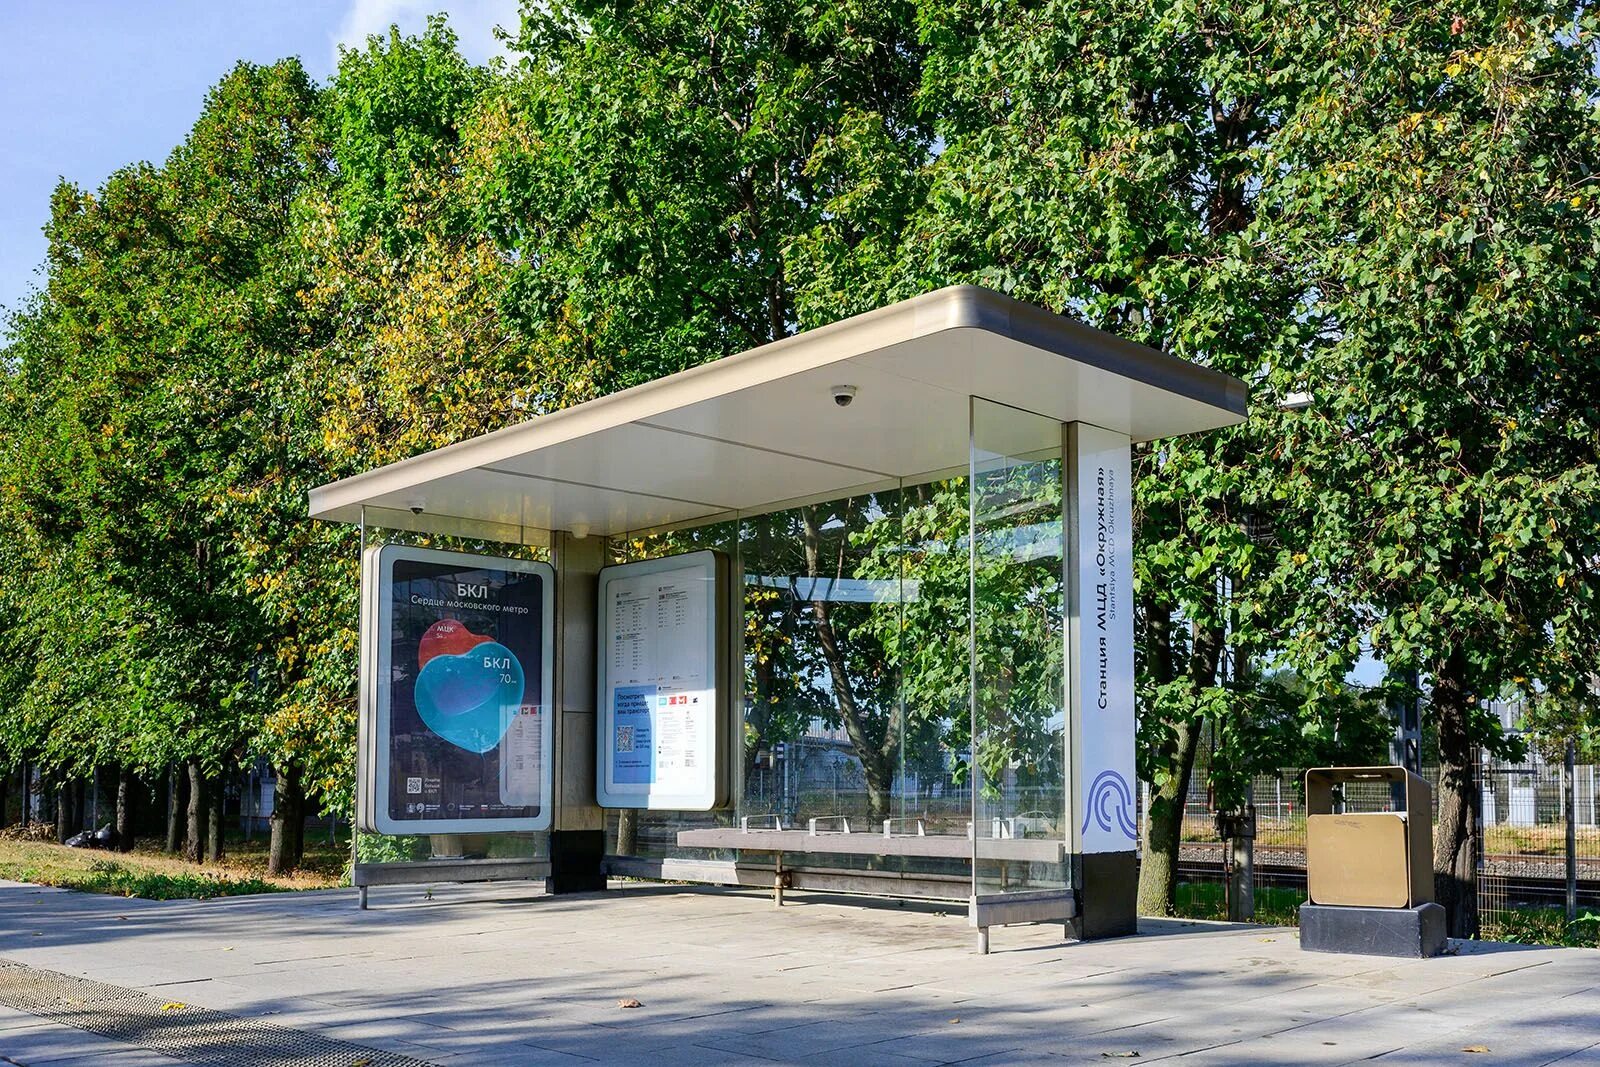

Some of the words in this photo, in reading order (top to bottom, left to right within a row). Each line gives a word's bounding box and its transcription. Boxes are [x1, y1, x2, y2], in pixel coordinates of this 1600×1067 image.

[1107, 469, 1116, 535] Okruzhnaya
[1096, 467, 1108, 577] «Окружная»
[1108, 538, 1116, 568] MCD
[411, 595, 444, 606] Сердце
[447, 601, 500, 611] московского
[502, 605, 529, 615] метро
[457, 583, 488, 599] БКЛ
[1096, 584, 1108, 632] МЦД
[1108, 571, 1116, 620] Stantsiya
[483, 657, 510, 669] БКЛ
[500, 674, 511, 683] 70
[1098, 637, 1108, 710] Станция
